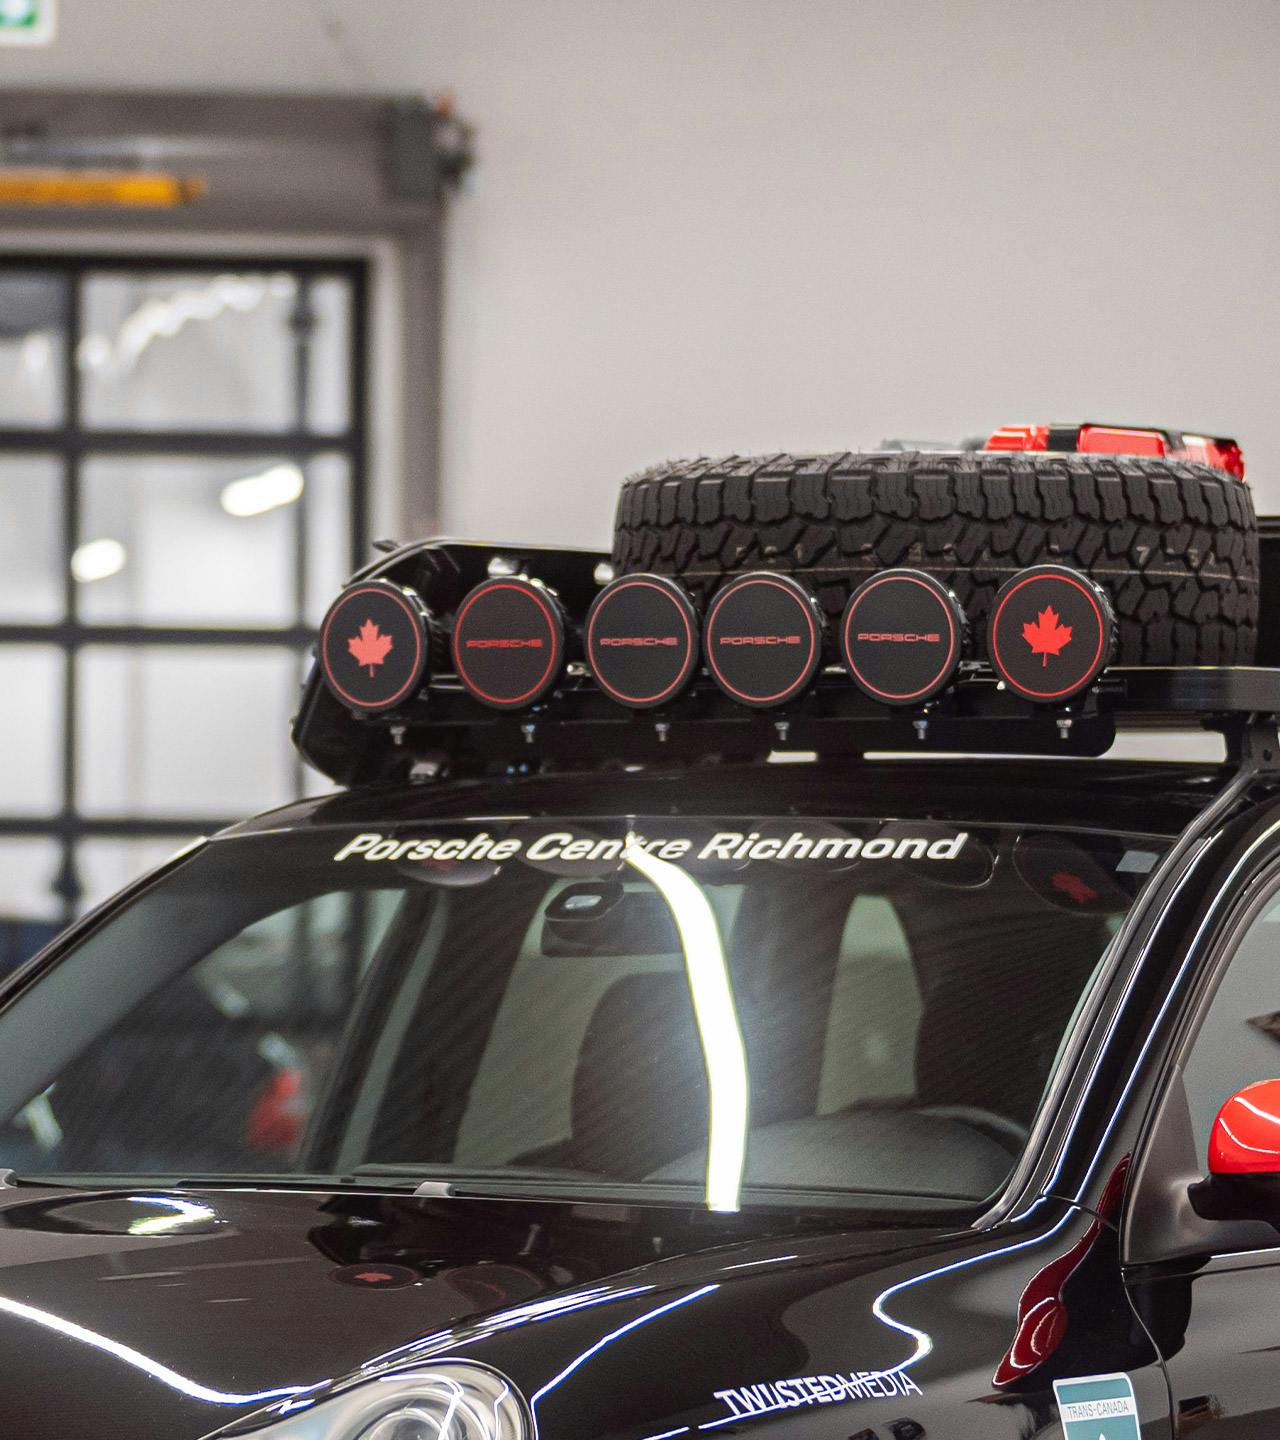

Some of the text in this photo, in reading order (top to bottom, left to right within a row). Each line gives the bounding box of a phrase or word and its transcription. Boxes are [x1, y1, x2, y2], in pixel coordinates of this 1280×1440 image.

[599, 636, 679, 646] PORSCHE
[720, 635, 802, 645] PORSCHE
[857, 632, 941, 643] PORSCHE
[465, 638, 544, 648] PORSCHE
[333, 832, 523, 862] Porsche
[696, 832, 969, 861] Richmond
[1066, 1401, 1130, 1419] TRANS-CANADA
